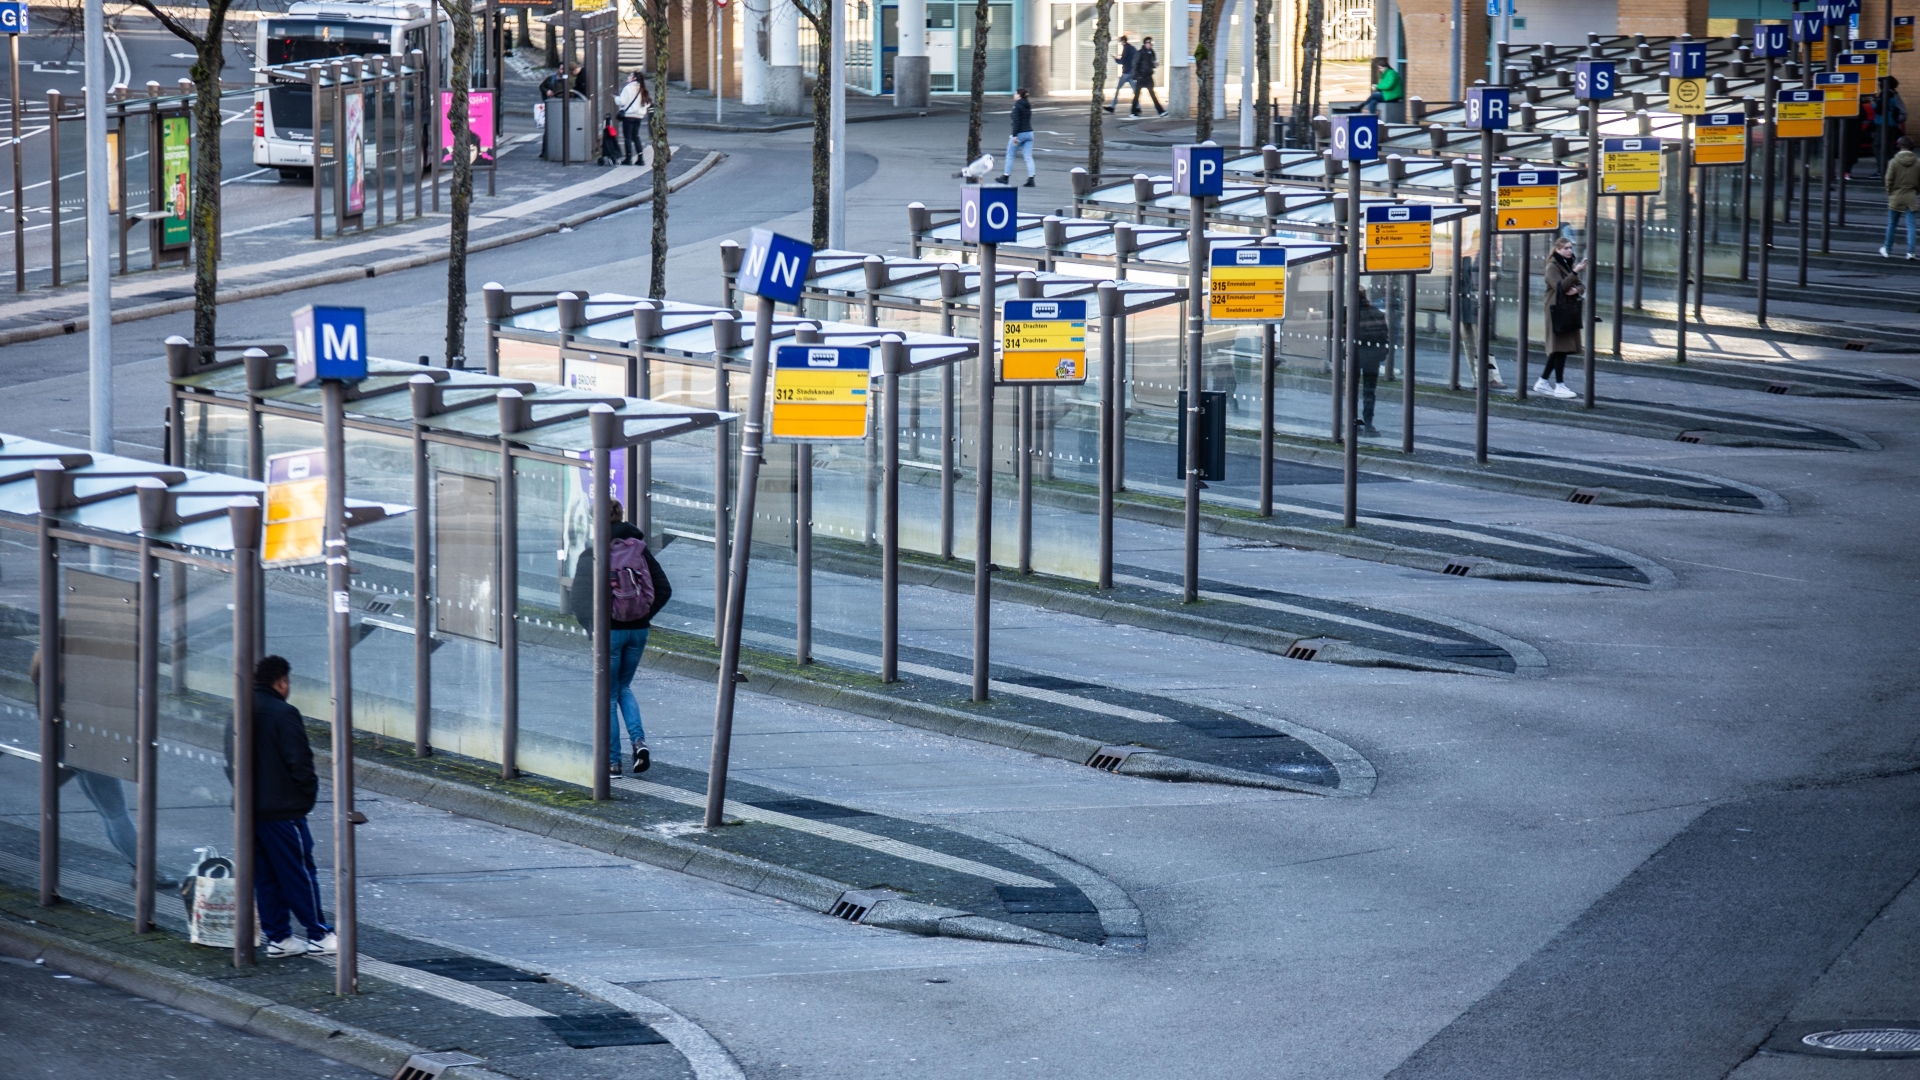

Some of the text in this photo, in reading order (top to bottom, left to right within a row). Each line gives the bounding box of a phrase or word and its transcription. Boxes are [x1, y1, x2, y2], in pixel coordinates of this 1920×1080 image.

[2, 9, 16, 26] G
[1830, 5, 1845, 18] W
[1794, 20, 1803, 34] V
[1808, 20, 1820, 34] V
[1756, 33, 1765, 49] U
[1771, 32, 1784, 49] U
[1672, 52, 1681, 69] T
[1688, 52, 1701, 69] T
[1578, 72, 1587, 90] S
[1596, 72, 1609, 90] S
[1489, 98, 1503, 119] R
[1335, 126, 1346, 150] Q
[1354, 126, 1372, 150] Q
[1178, 158, 1187, 183] P
[1200, 160, 1216, 184] P
[965, 200, 977, 228] O
[987, 201, 1009, 229] O
[1376, 225, 1380, 233] 5
[1376, 237, 1380, 245] 6
[745, 244, 765, 278] N
[770, 250, 800, 288] N
[1212, 282, 1226, 291] 315
[1212, 295, 1226, 304] 324
[1005, 324, 1021, 334] 304
[296, 325, 313, 366] M
[322, 323, 358, 361] M
[1005, 339, 1020, 348] 314
[776, 389, 794, 400] 312
